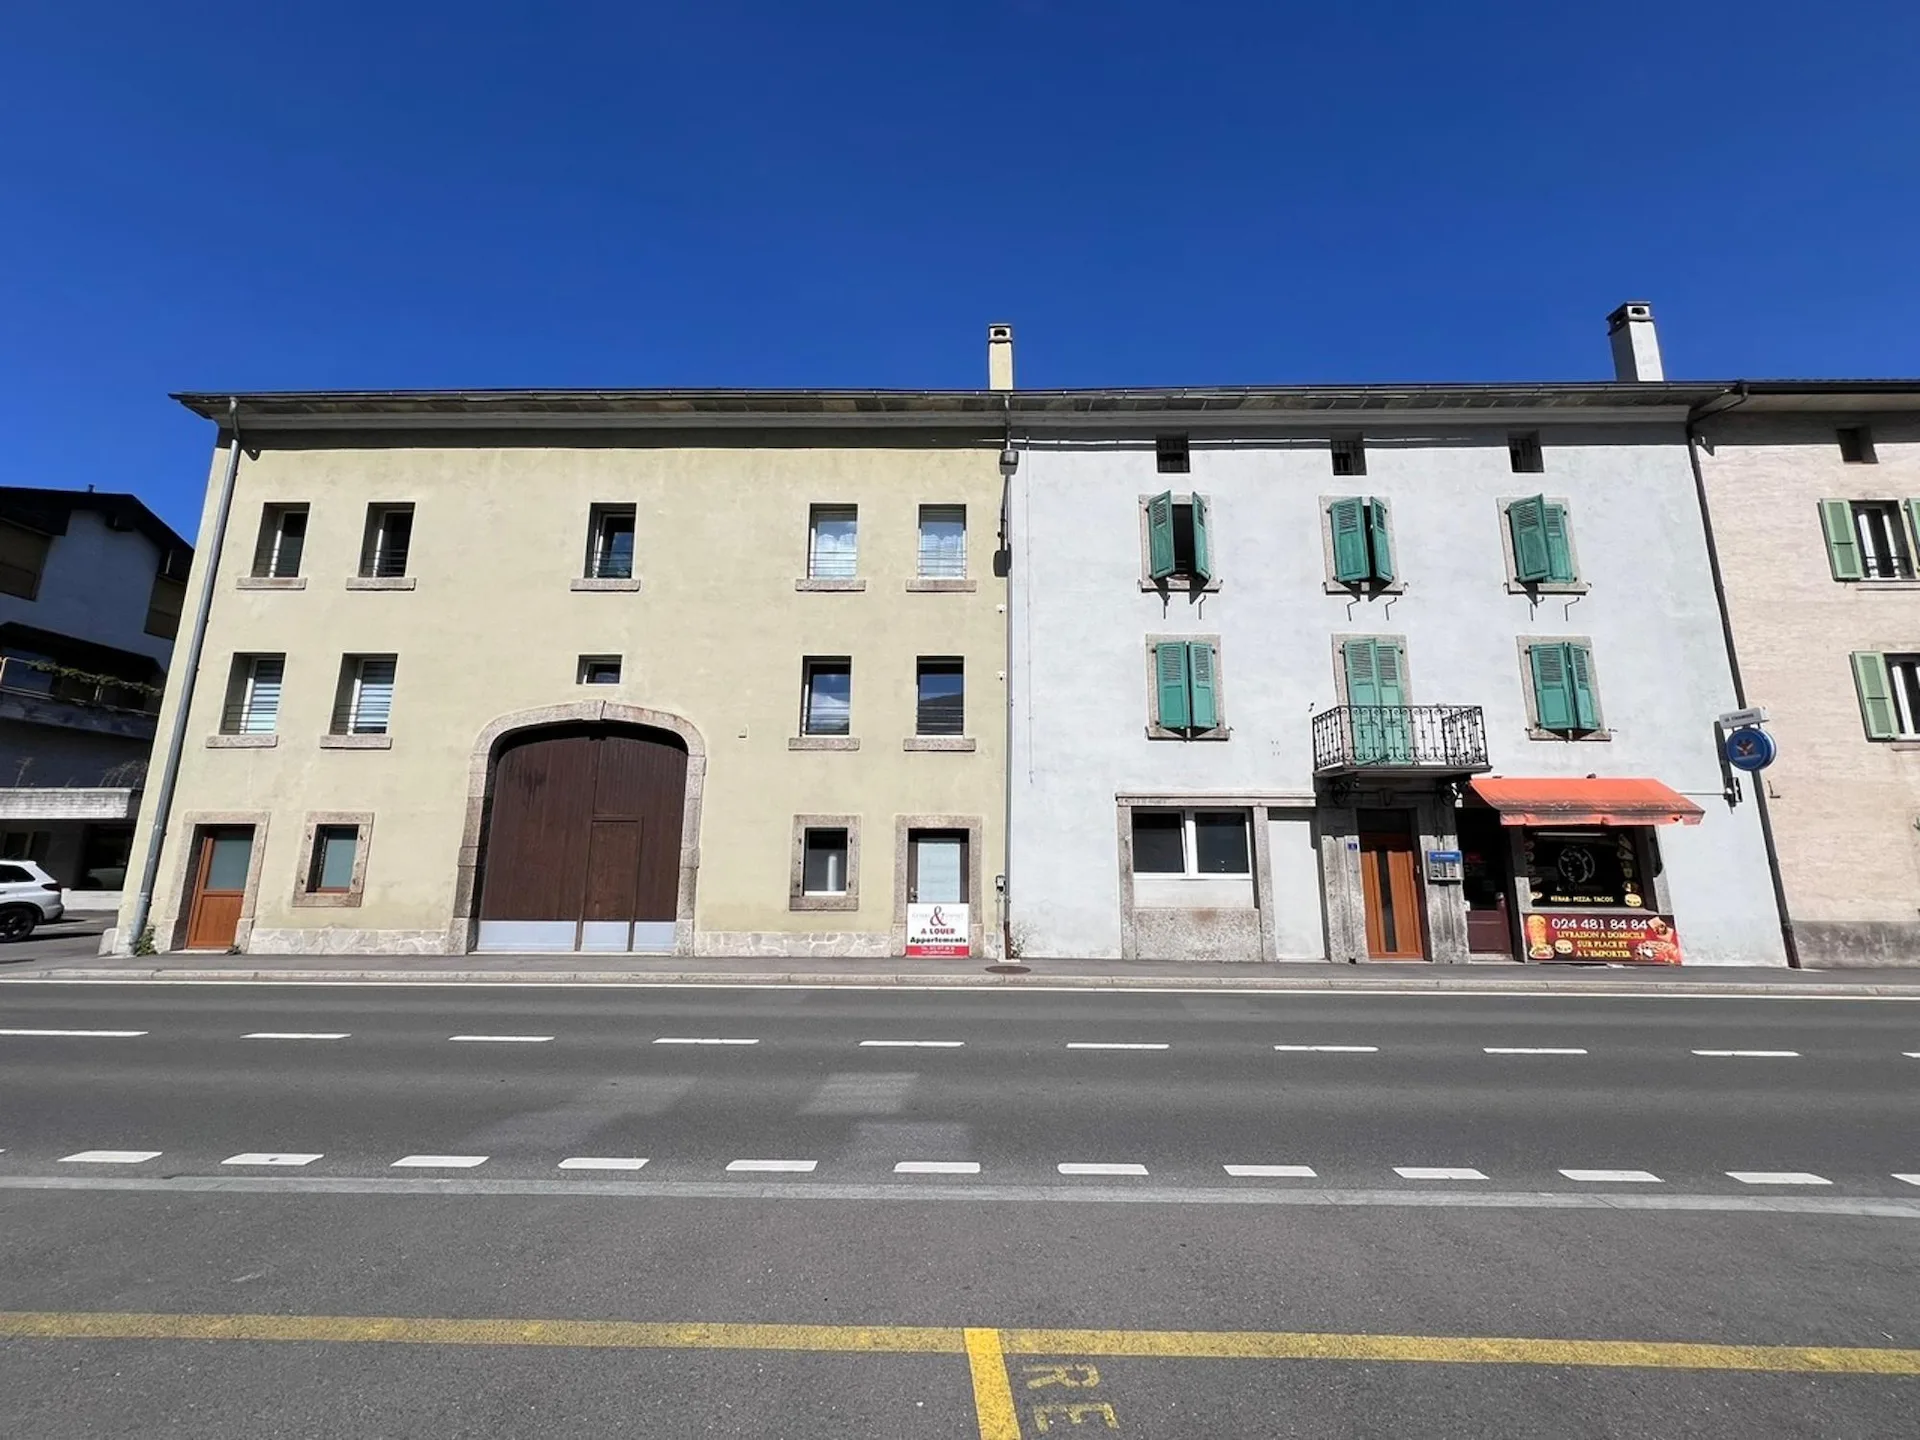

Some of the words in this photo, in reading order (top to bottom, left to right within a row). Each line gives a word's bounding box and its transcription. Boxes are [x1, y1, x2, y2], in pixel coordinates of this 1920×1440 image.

[1551, 917, 1577, 929] 024
[1580, 918, 1604, 930] 481
[1610, 919, 1627, 930] 84
[1630, 919, 1648, 930] 84
[929, 927, 955, 935] LOUER
[1607, 931, 1646, 939] DOMICILE
[1576, 940, 1592, 948] SUR
[1593, 940, 1618, 948] PLACE
[1618, 940, 1628, 948] ET
